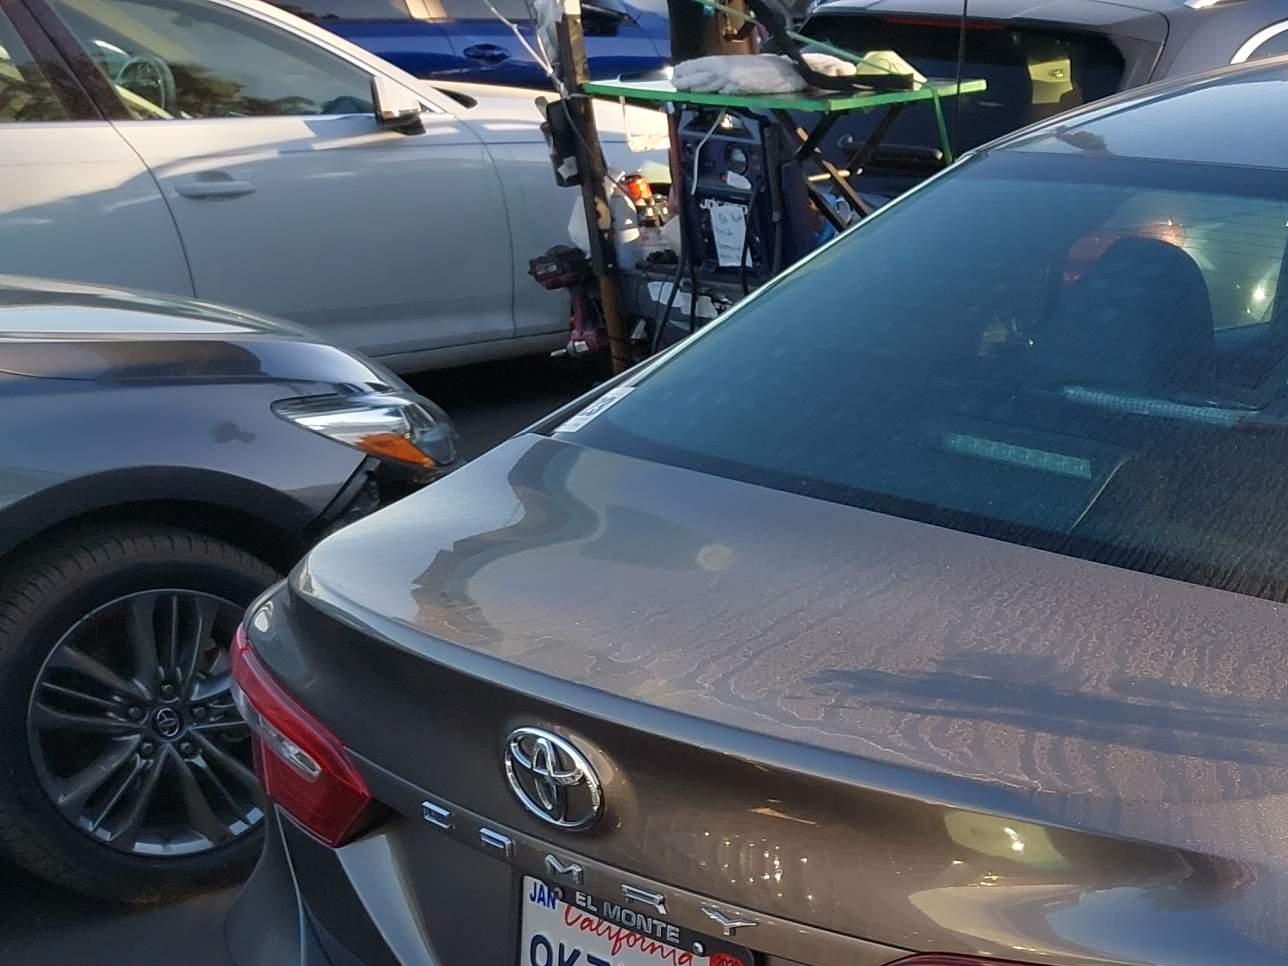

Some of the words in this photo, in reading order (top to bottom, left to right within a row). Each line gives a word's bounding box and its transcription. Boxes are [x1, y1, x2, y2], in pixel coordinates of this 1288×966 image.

[421, 800, 759, 938] CAMRY
[528, 881, 557, 910] JAN
[575, 891, 598, 912] EL
[603, 901, 681, 945] MONTE
